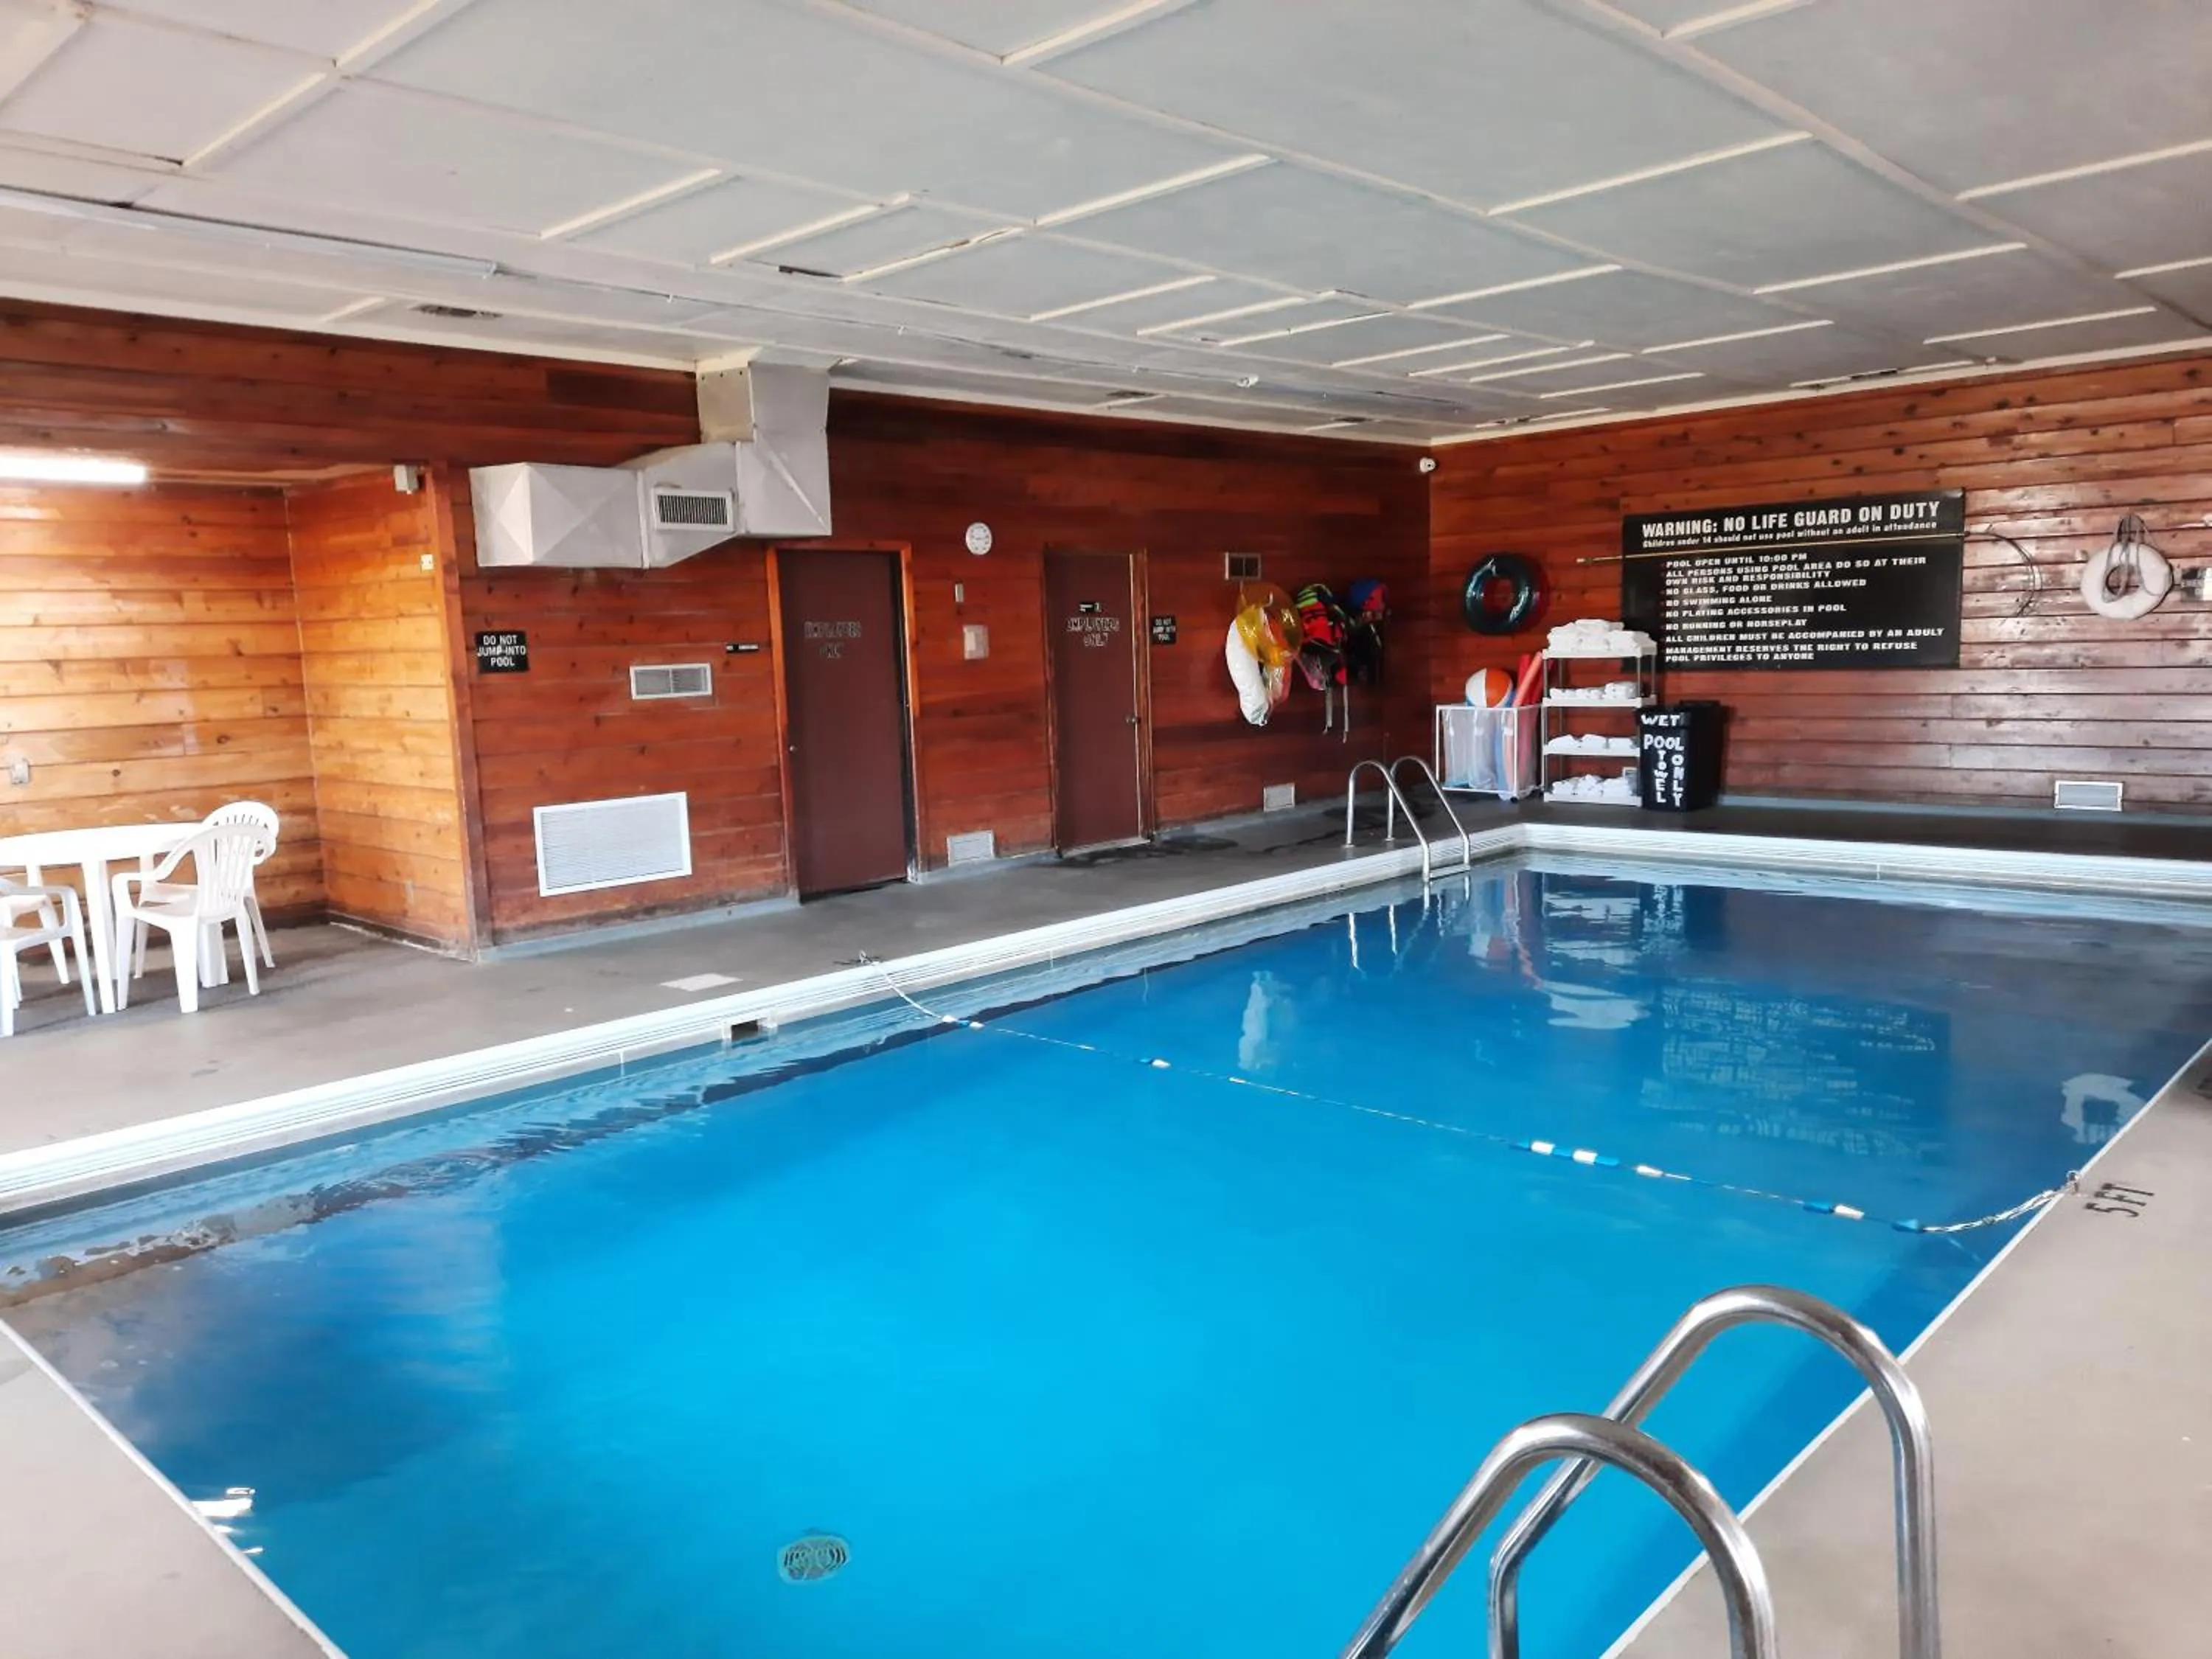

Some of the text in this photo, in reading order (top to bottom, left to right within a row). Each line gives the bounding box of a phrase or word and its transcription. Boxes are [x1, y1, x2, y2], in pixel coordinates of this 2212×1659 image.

[1642, 501, 1940, 538] WARNING: NO LIFE GUARD ON DUTY
[1713, 533, 1741, 543] should
[1742, 532, 1757, 540] not
[1776, 530, 1795, 540] pool
[1797, 527, 1830, 538] without
[1872, 524, 1881, 532] in
[1884, 521, 1937, 532] attendance
[1666, 553, 1807, 568] POOL OPEN UNTIL 10:00 PM
[1666, 557, 1927, 578] ALL PERSONS USING POOL AREA DO SO AT THEIR
[1666, 570, 1831, 585] OWN RISK AND RESPONSIBILITY
[1752, 583, 1767, 591] OR
[1770, 582, 1810, 590] DRINKS
[1813, 579, 1867, 588] ALLOWED
[1683, 597, 1736, 606] SWIMMING
[1739, 595, 1773, 603] ALONE
[1682, 608, 1724, 617] PLAYING
[1727, 605, 1799, 615] ACCESSORIES
[1818, 604, 1846, 612] POOL
[1682, 622, 1726, 630] RUNNING
[1729, 620, 1743, 628] OR
[1747, 619, 1807, 627] HORSEPLAY
[483, 635, 518, 645] DO NOT
[1666, 635, 1683, 643] ALL
[1686, 633, 1736, 641] CHILDREN
[1739, 632, 1767, 641] MUST
[1788, 630, 1865, 639] ACCOMPANIED
[1868, 630, 1883, 638] BY
[1887, 628, 1902, 637] AN
[1666, 641, 1918, 654] MANAGEMENT RESERVES THE RIGHT TO REFUSE
[490, 656, 515, 667] POOL
[1694, 653, 1753, 661] PRIVILEGES
[1757, 653, 1770, 661] TO
[1773, 653, 1815, 661] ANYONE
[1641, 714, 1680, 726] WET
[1644, 734, 1685, 751] POOL
[1654, 750, 1668, 803] TOWEL
[1672, 754, 1685, 807] ONLY
